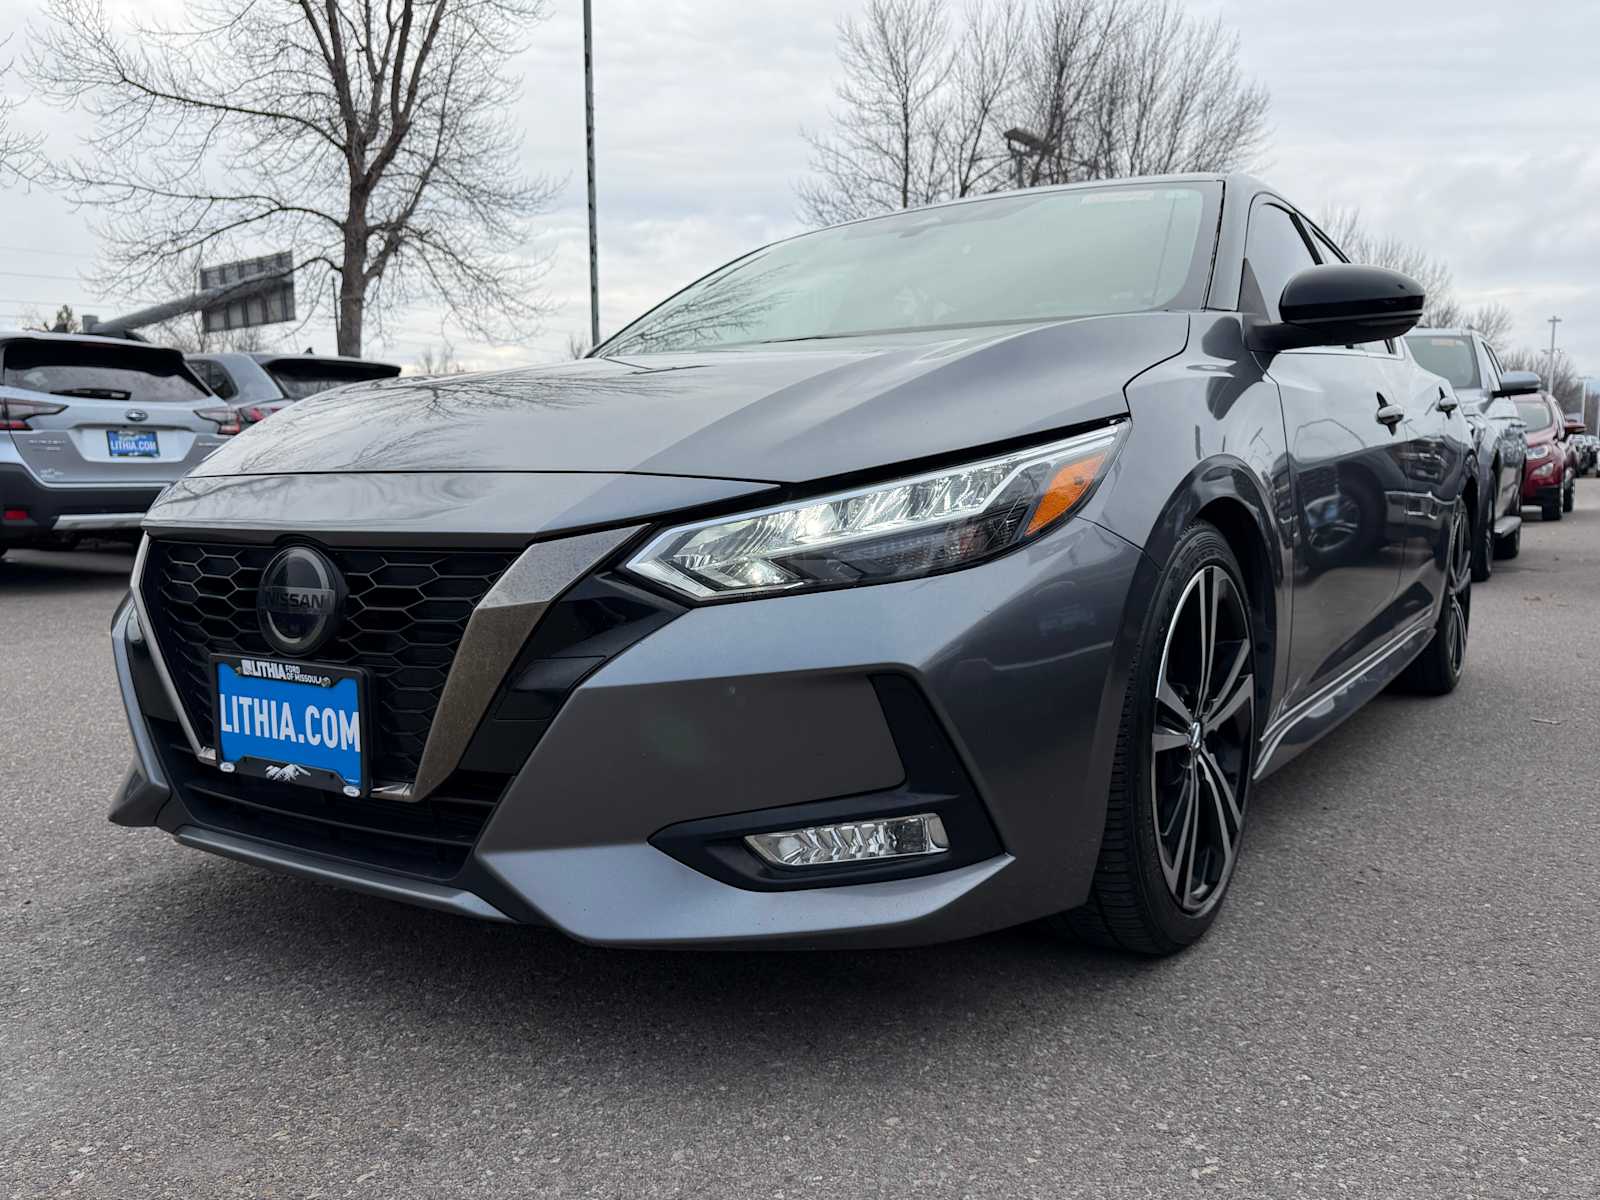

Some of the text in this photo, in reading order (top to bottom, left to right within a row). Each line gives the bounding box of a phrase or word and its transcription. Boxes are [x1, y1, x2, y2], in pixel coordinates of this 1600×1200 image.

[110, 439, 156, 450] LITHIA.COM
[265, 591, 324, 608] NISSAN
[252, 660, 286, 680] LITHIA
[286, 665, 300, 674] FORD
[220, 694, 361, 752] LITHIA.COM
